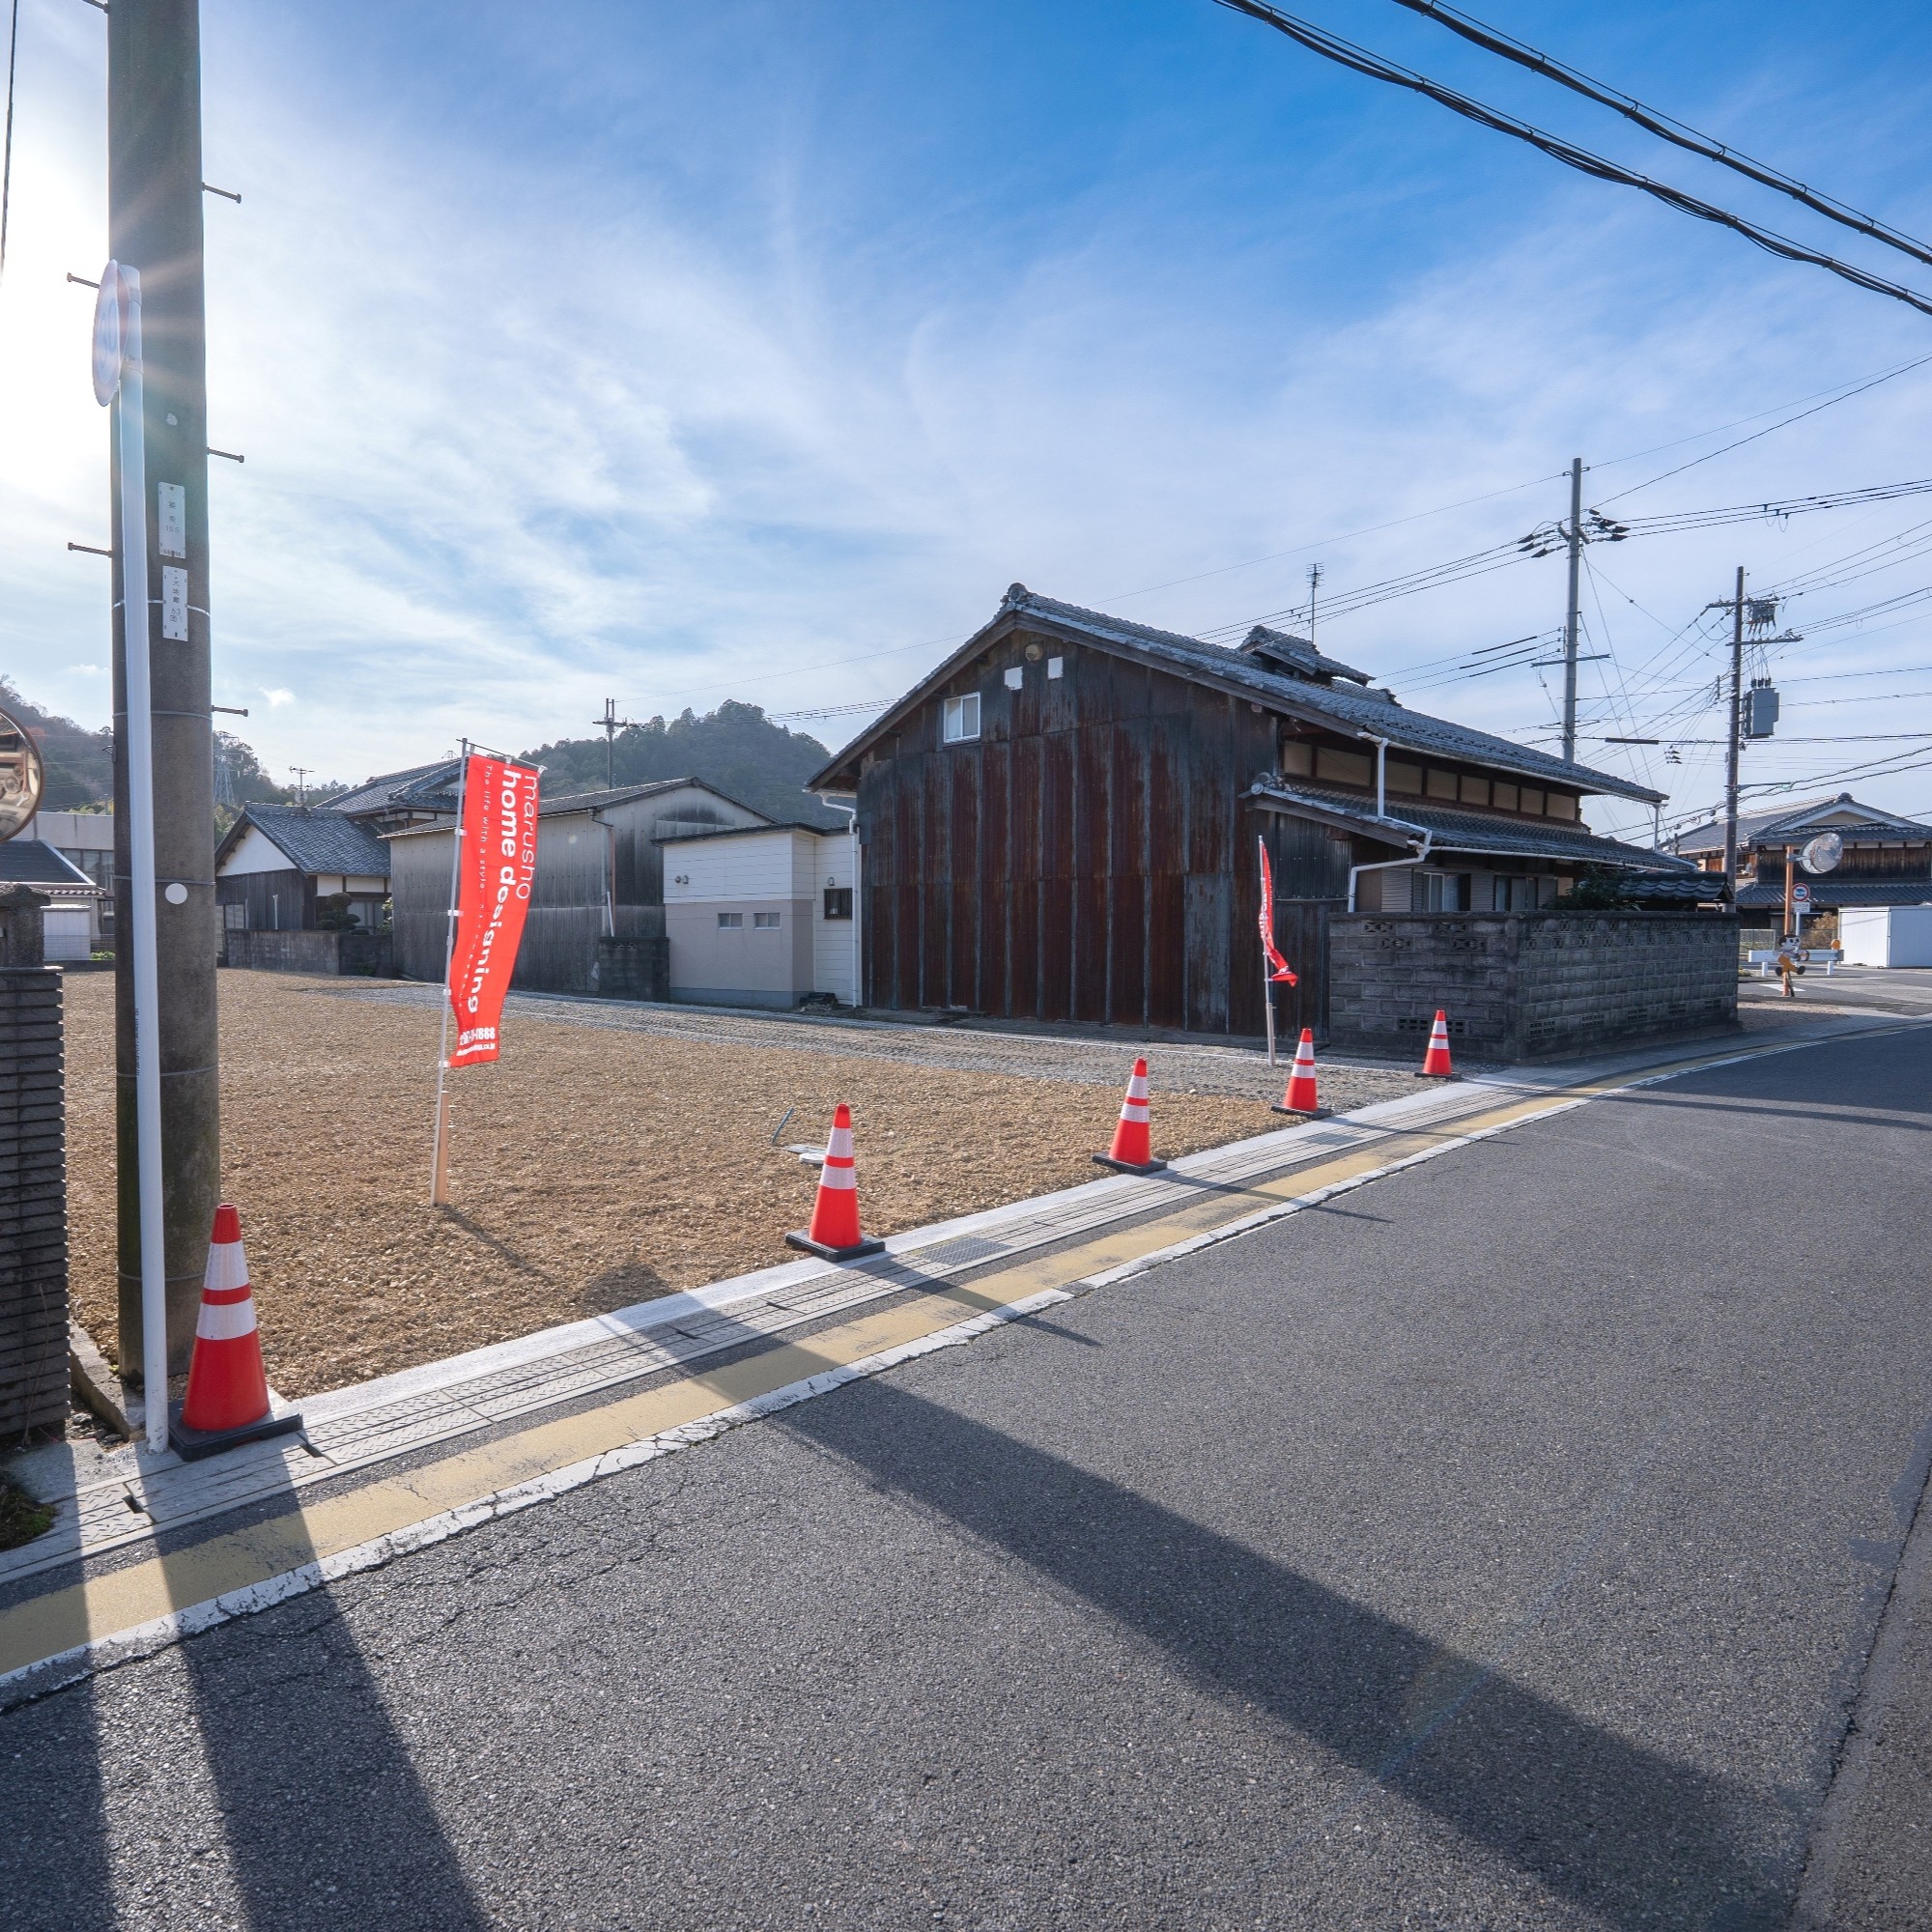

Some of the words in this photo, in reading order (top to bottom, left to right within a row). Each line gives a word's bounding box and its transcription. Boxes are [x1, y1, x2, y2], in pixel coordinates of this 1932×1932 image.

[484, 764, 493, 785] The
[500, 769, 522, 858] home
[480, 816, 489, 842] with
[516, 775, 538, 899] marusho
[468, 866, 517, 1013] designing
